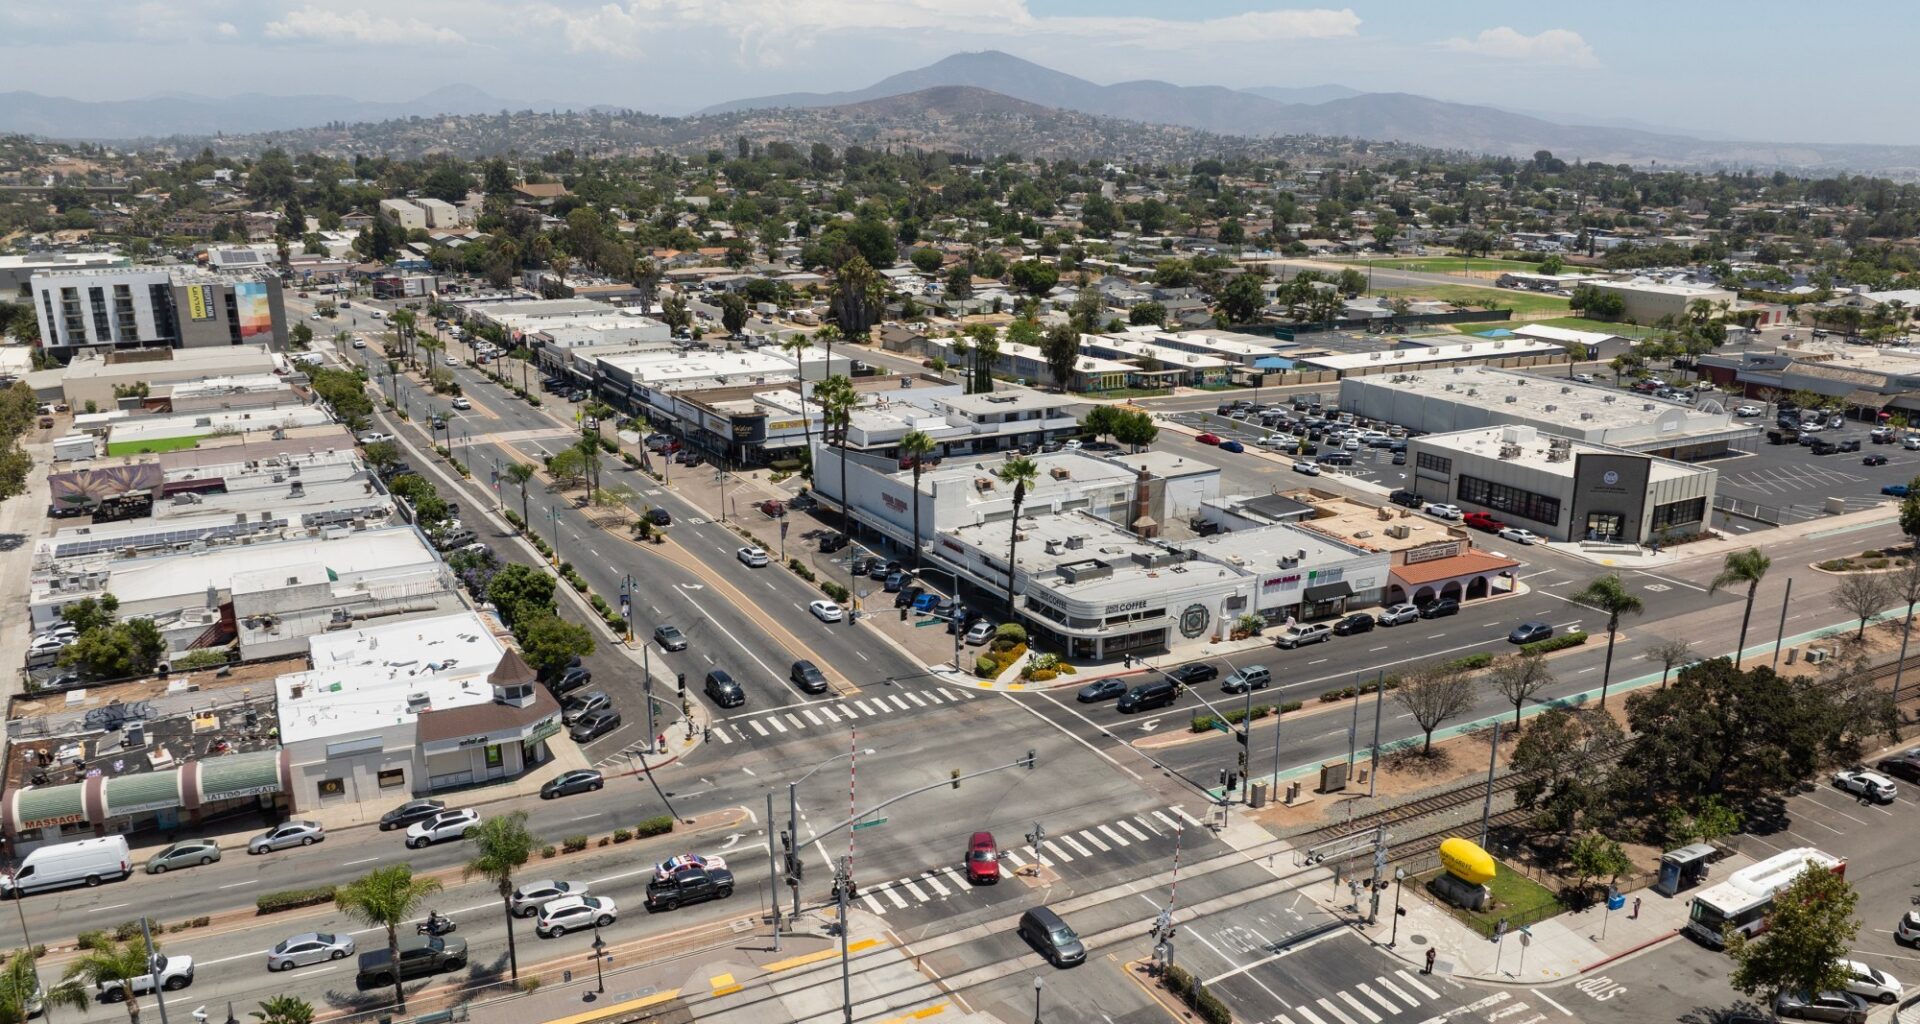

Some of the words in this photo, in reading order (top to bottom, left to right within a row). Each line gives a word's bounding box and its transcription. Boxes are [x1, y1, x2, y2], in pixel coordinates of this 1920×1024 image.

[1119, 600, 1147, 612] COFFEE
[206, 790, 241, 801] TATTOO
[251, 784, 278, 796] SKATE
[24, 814, 84, 829] MASSAGE
[1575, 976, 1627, 1001] STOP
